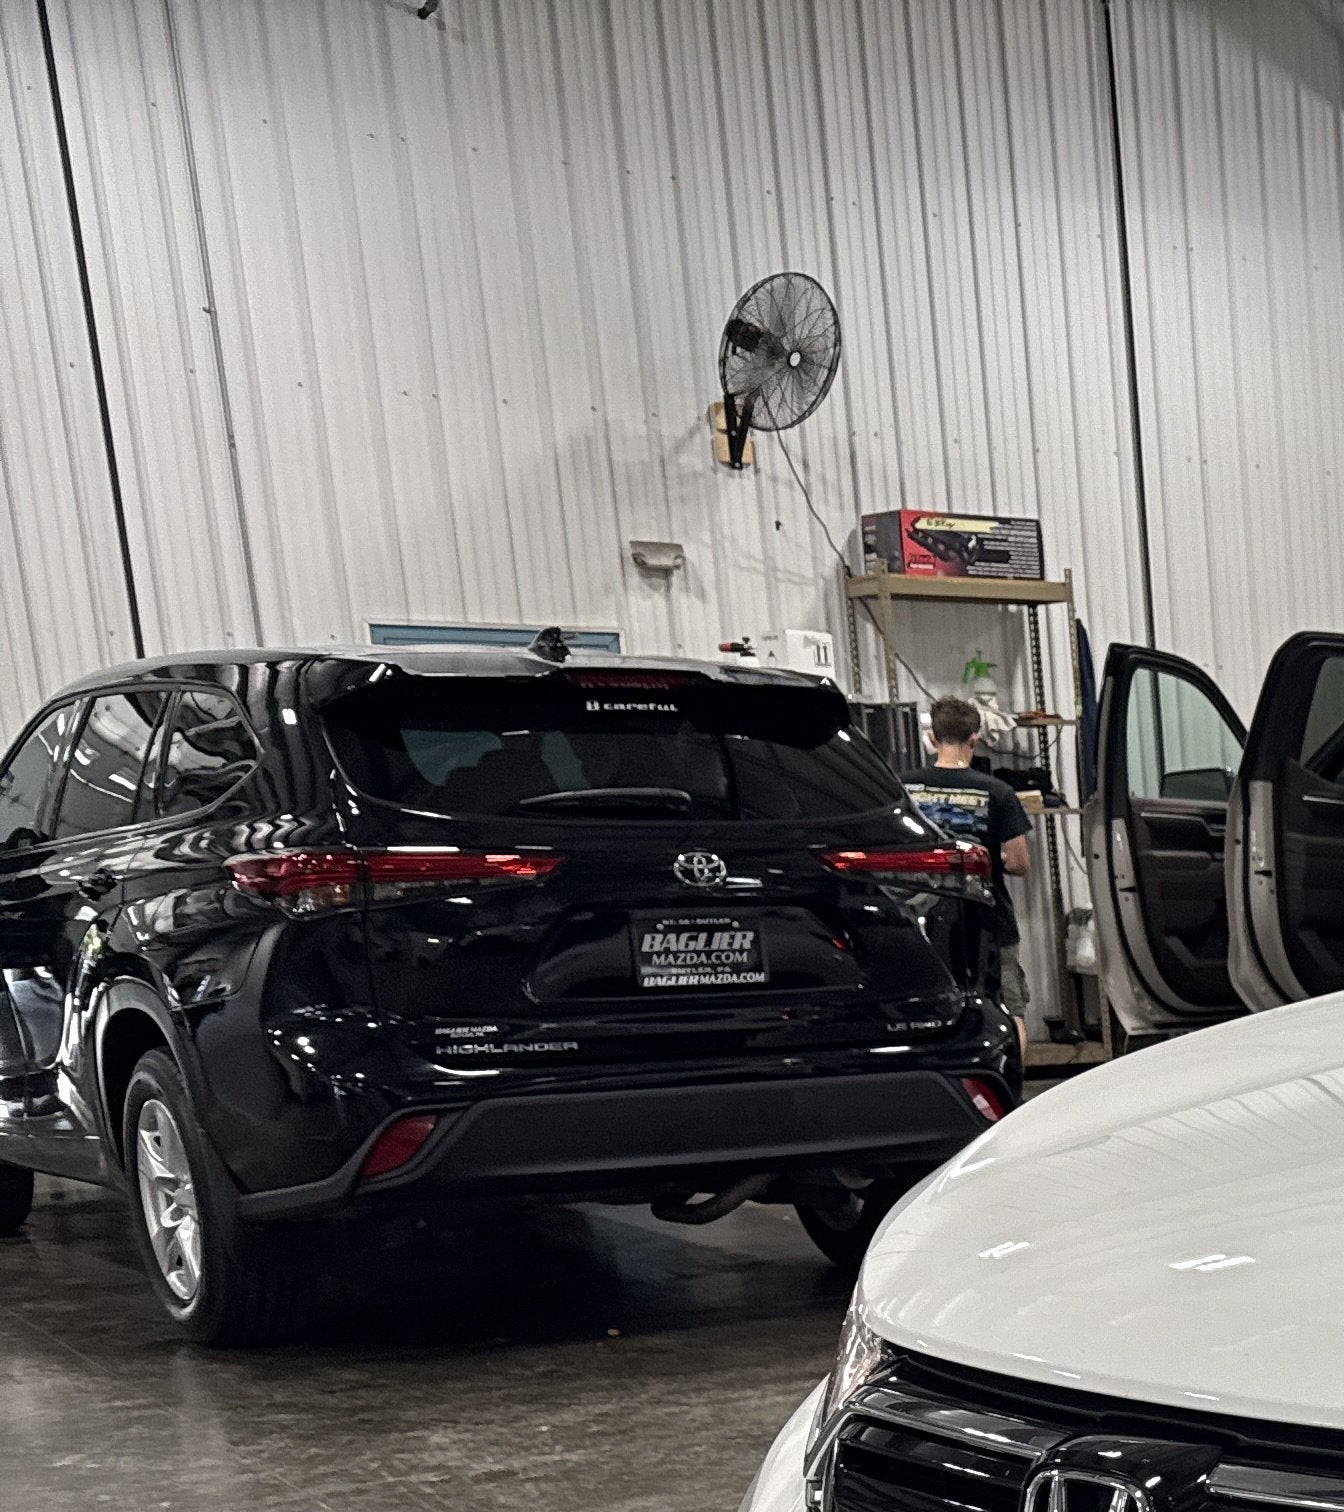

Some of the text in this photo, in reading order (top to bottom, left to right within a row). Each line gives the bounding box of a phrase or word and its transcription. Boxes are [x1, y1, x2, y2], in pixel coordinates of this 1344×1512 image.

[641, 931, 754, 952] BAGLIER
[652, 951, 748, 965] MAZDA.COM
[436, 1041, 579, 1055] HIGHLANDER
